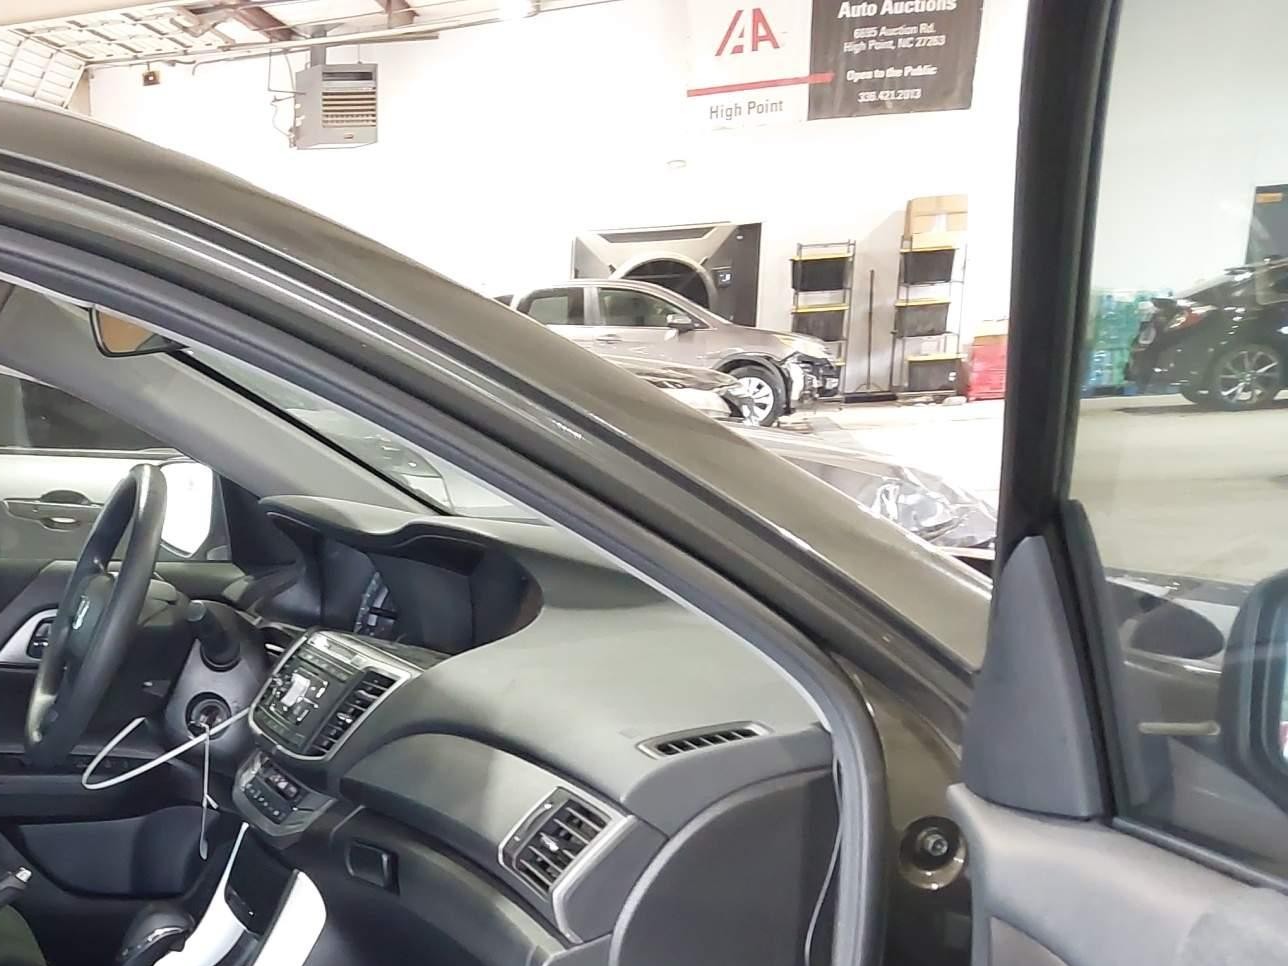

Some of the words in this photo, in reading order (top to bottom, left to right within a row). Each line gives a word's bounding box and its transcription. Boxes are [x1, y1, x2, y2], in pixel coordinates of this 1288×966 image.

[837, 1, 878, 18] Auto
[880, 0, 958, 15] Auctions
[878, 24, 918, 37] Auction
[843, 41, 867, 55] High
[897, 37, 914, 48] NC
[846, 70, 873, 83] Open
[873, 69, 885, 79] to
[885, 67, 903, 78] the
[903, 64, 938, 77] Public
[709, 103, 742, 120] High
[747, 99, 783, 115] Point
